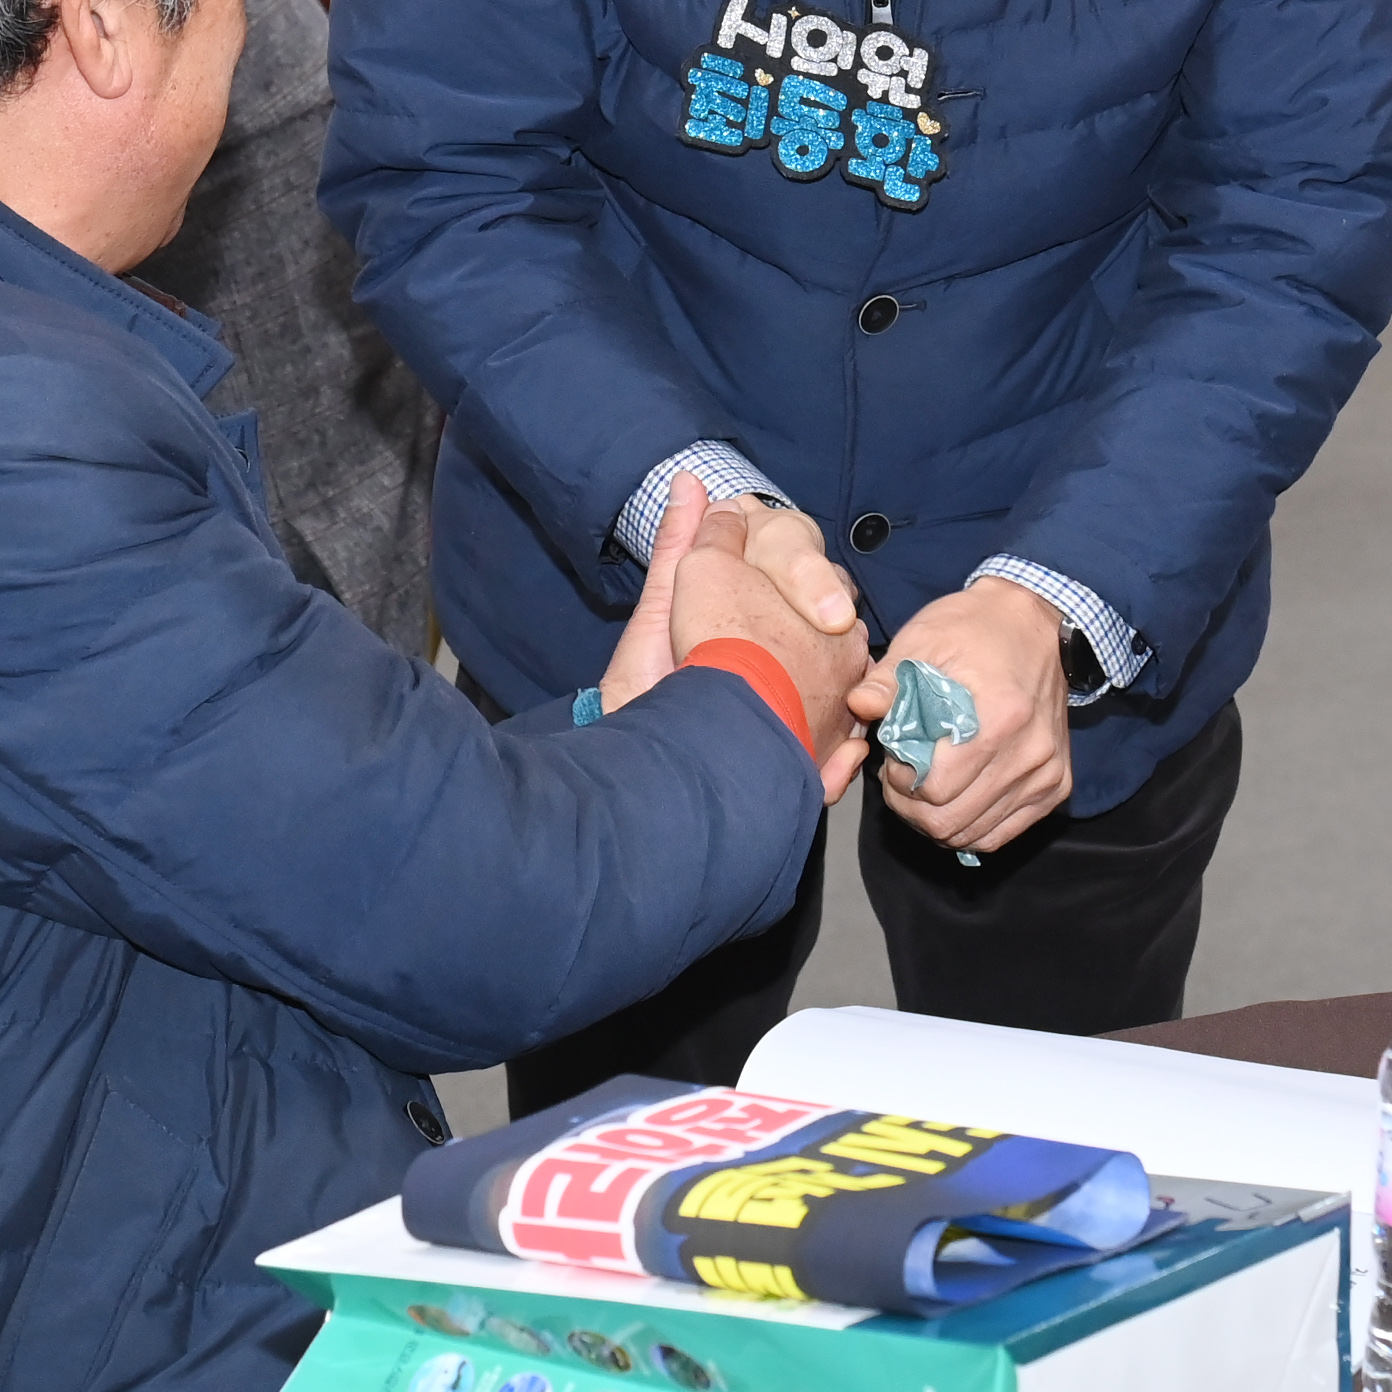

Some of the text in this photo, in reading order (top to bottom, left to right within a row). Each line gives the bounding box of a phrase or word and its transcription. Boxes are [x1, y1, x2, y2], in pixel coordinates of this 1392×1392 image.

[685, 52, 940, 202] 최동환
[512, 1089, 833, 1274] 정하라
[821, 1114, 1010, 1175] 시
